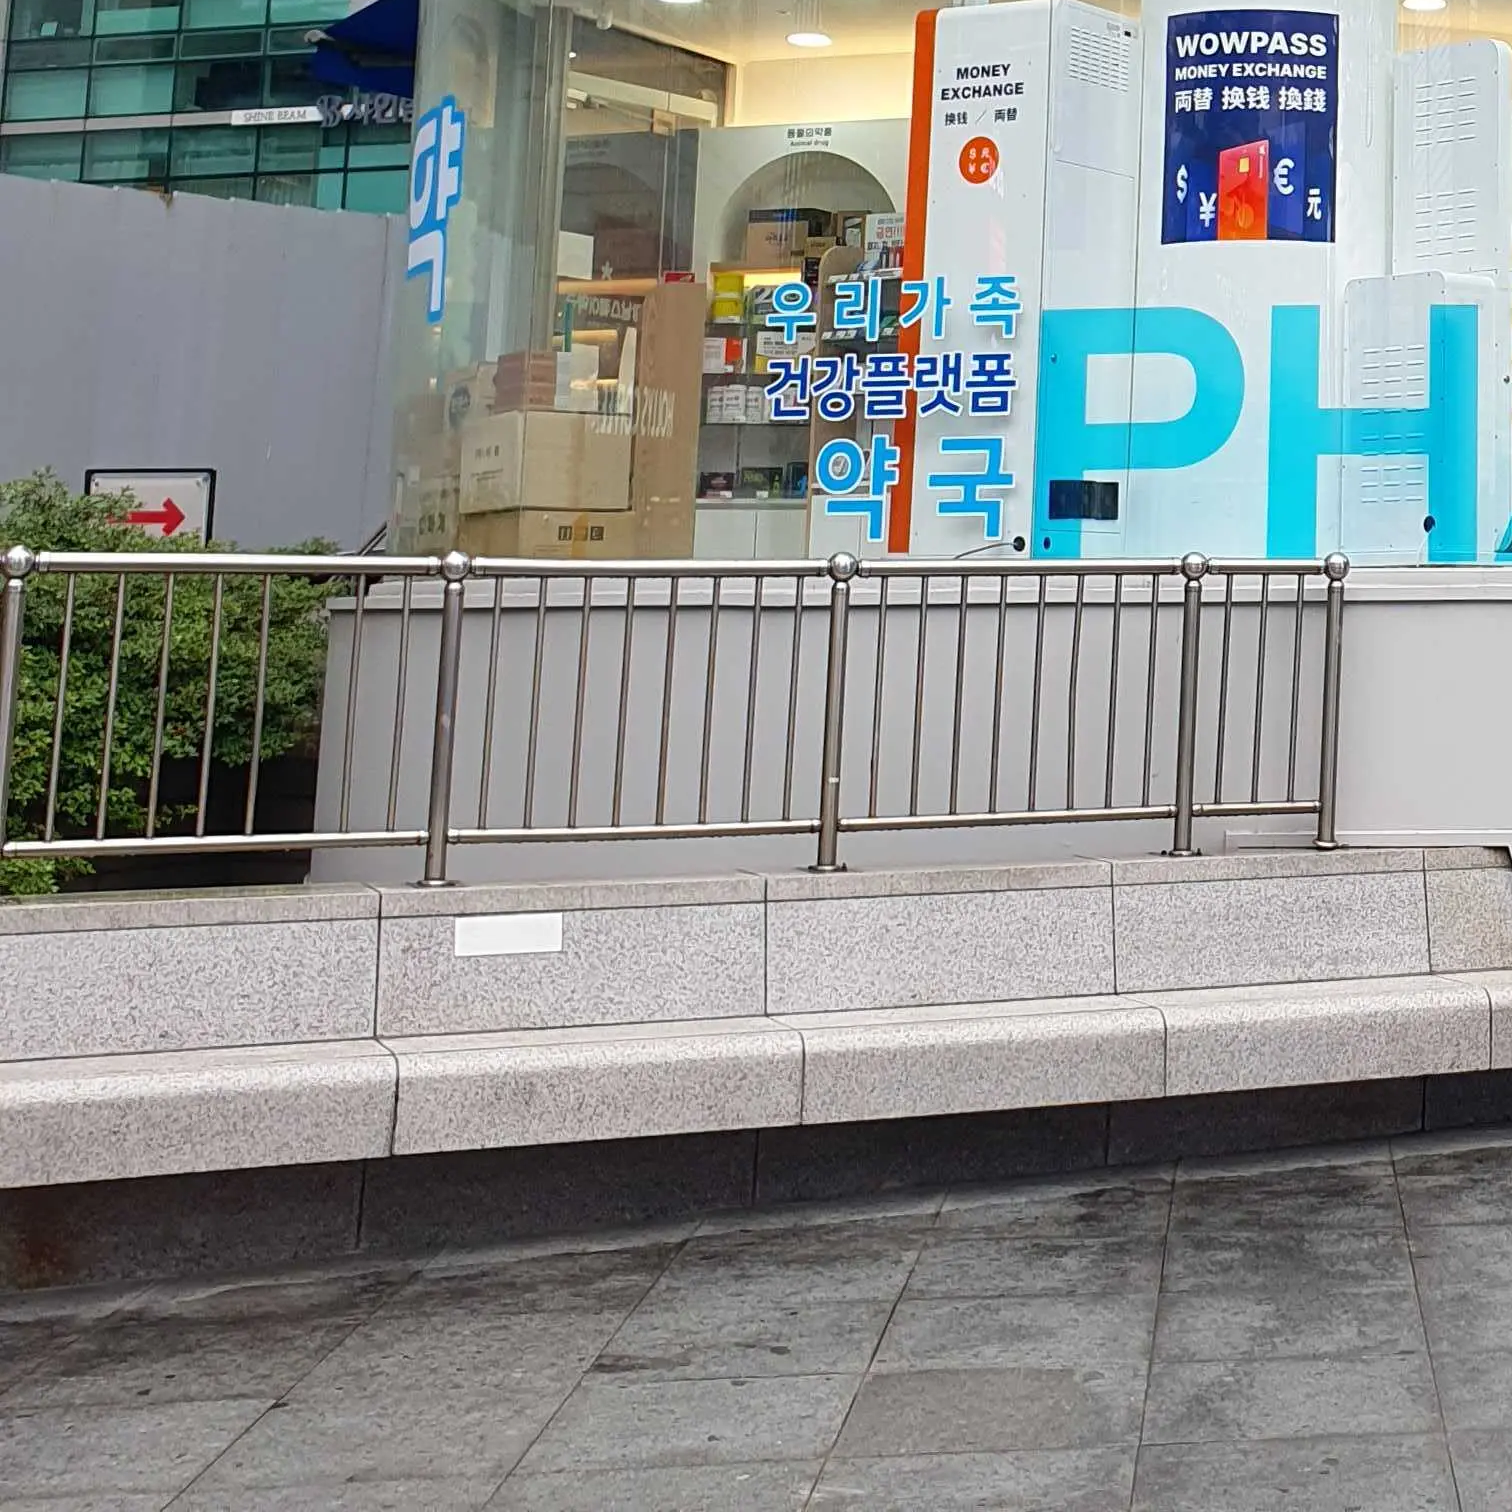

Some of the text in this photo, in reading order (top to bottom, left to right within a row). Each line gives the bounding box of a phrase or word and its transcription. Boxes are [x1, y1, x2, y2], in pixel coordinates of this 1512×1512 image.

[1175, 31, 1327, 58] WOWPASS
[956, 63, 1011, 81] MONEY
[1175, 62, 1328, 81] MONEY EXCHANGE
[940, 81, 1025, 101] EXCHANGE
[243, 108, 307, 122] SHINE BEAM
[765, 352, 1017, 421] 건강플랫폼
[816, 434, 1016, 541] 약국
